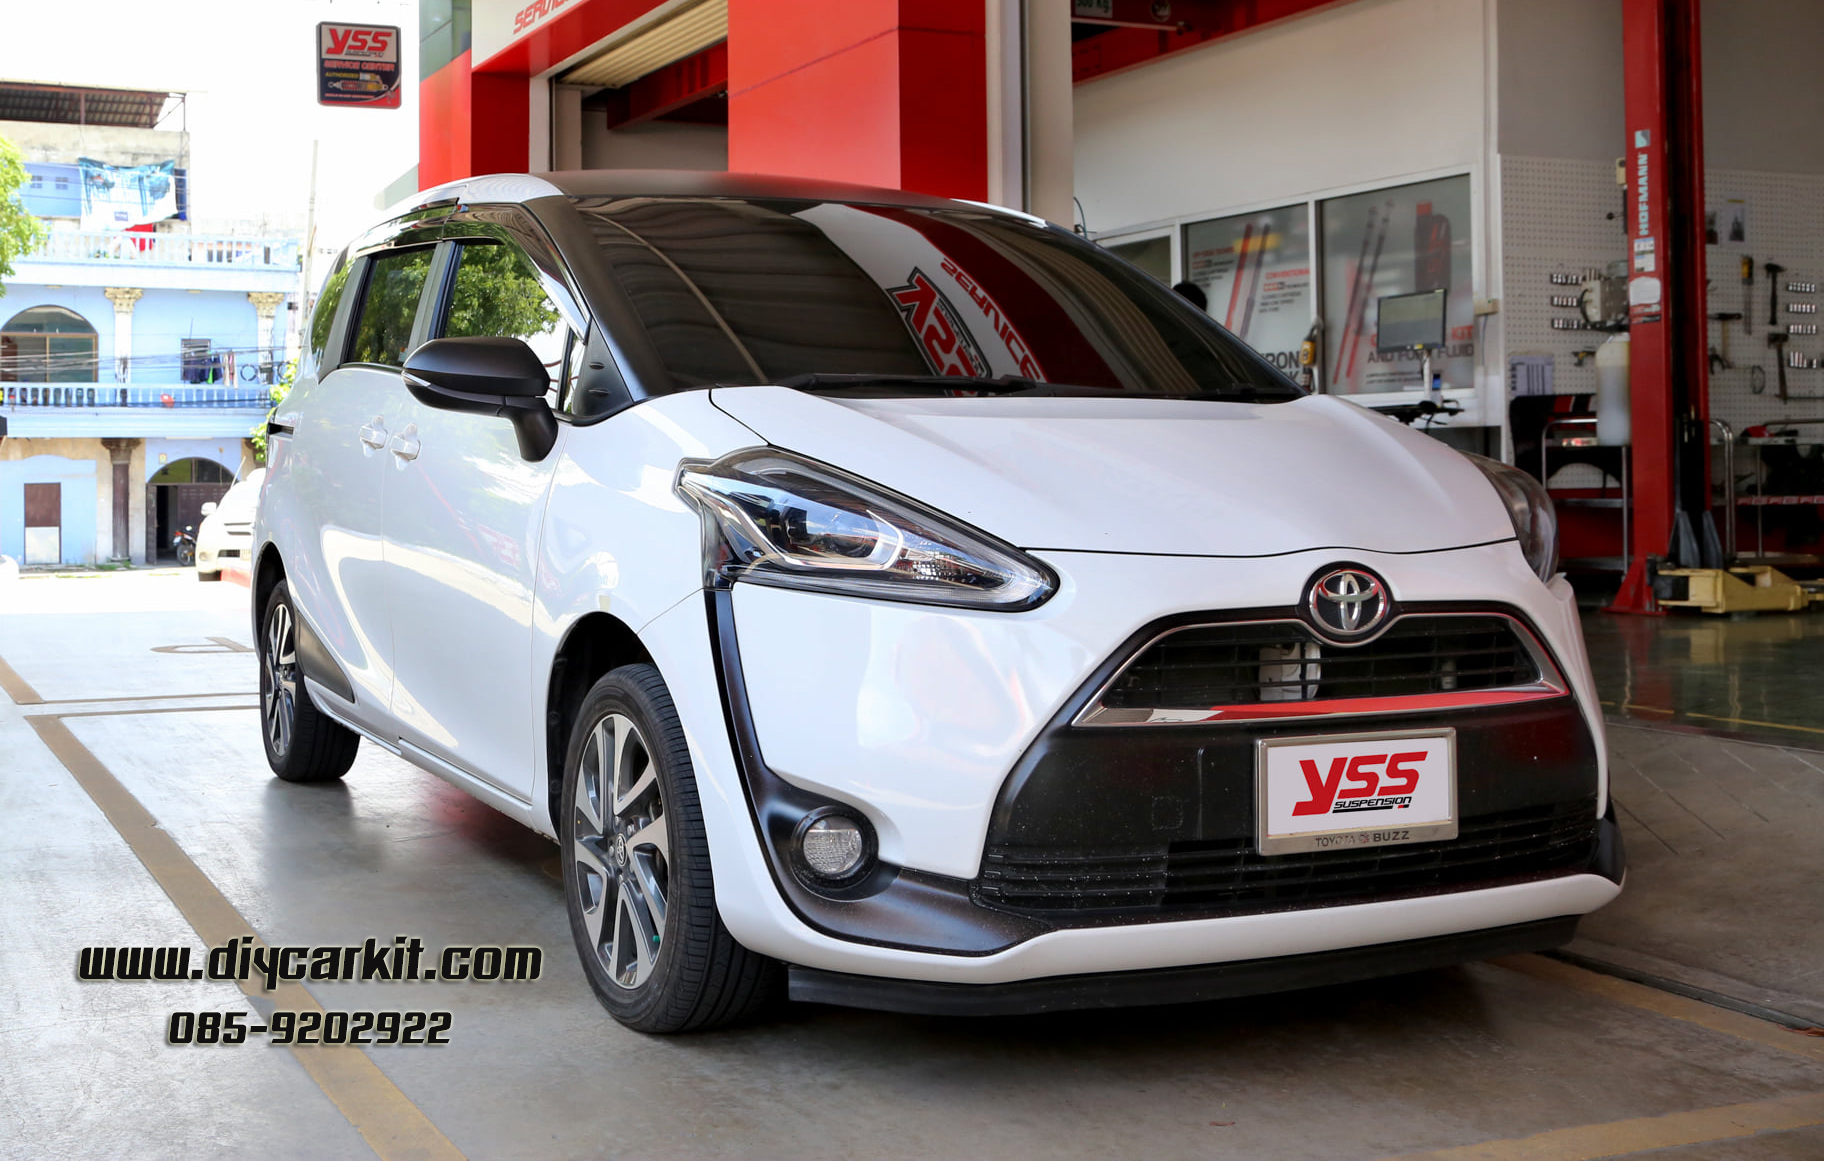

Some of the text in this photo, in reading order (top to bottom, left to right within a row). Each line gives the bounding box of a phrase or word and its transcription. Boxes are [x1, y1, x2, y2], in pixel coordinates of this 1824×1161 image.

[513, 0, 569, 34] SERVI
[326, 28, 393, 55] YSS
[324, 60, 396, 72] SERVICE CENTER
[1637, 153, 1650, 236] HOFMANN
[1291, 751, 1428, 816] YSS
[1333, 796, 1412, 809] SUSPENSION
[1373, 830, 1410, 843] BUZZ
